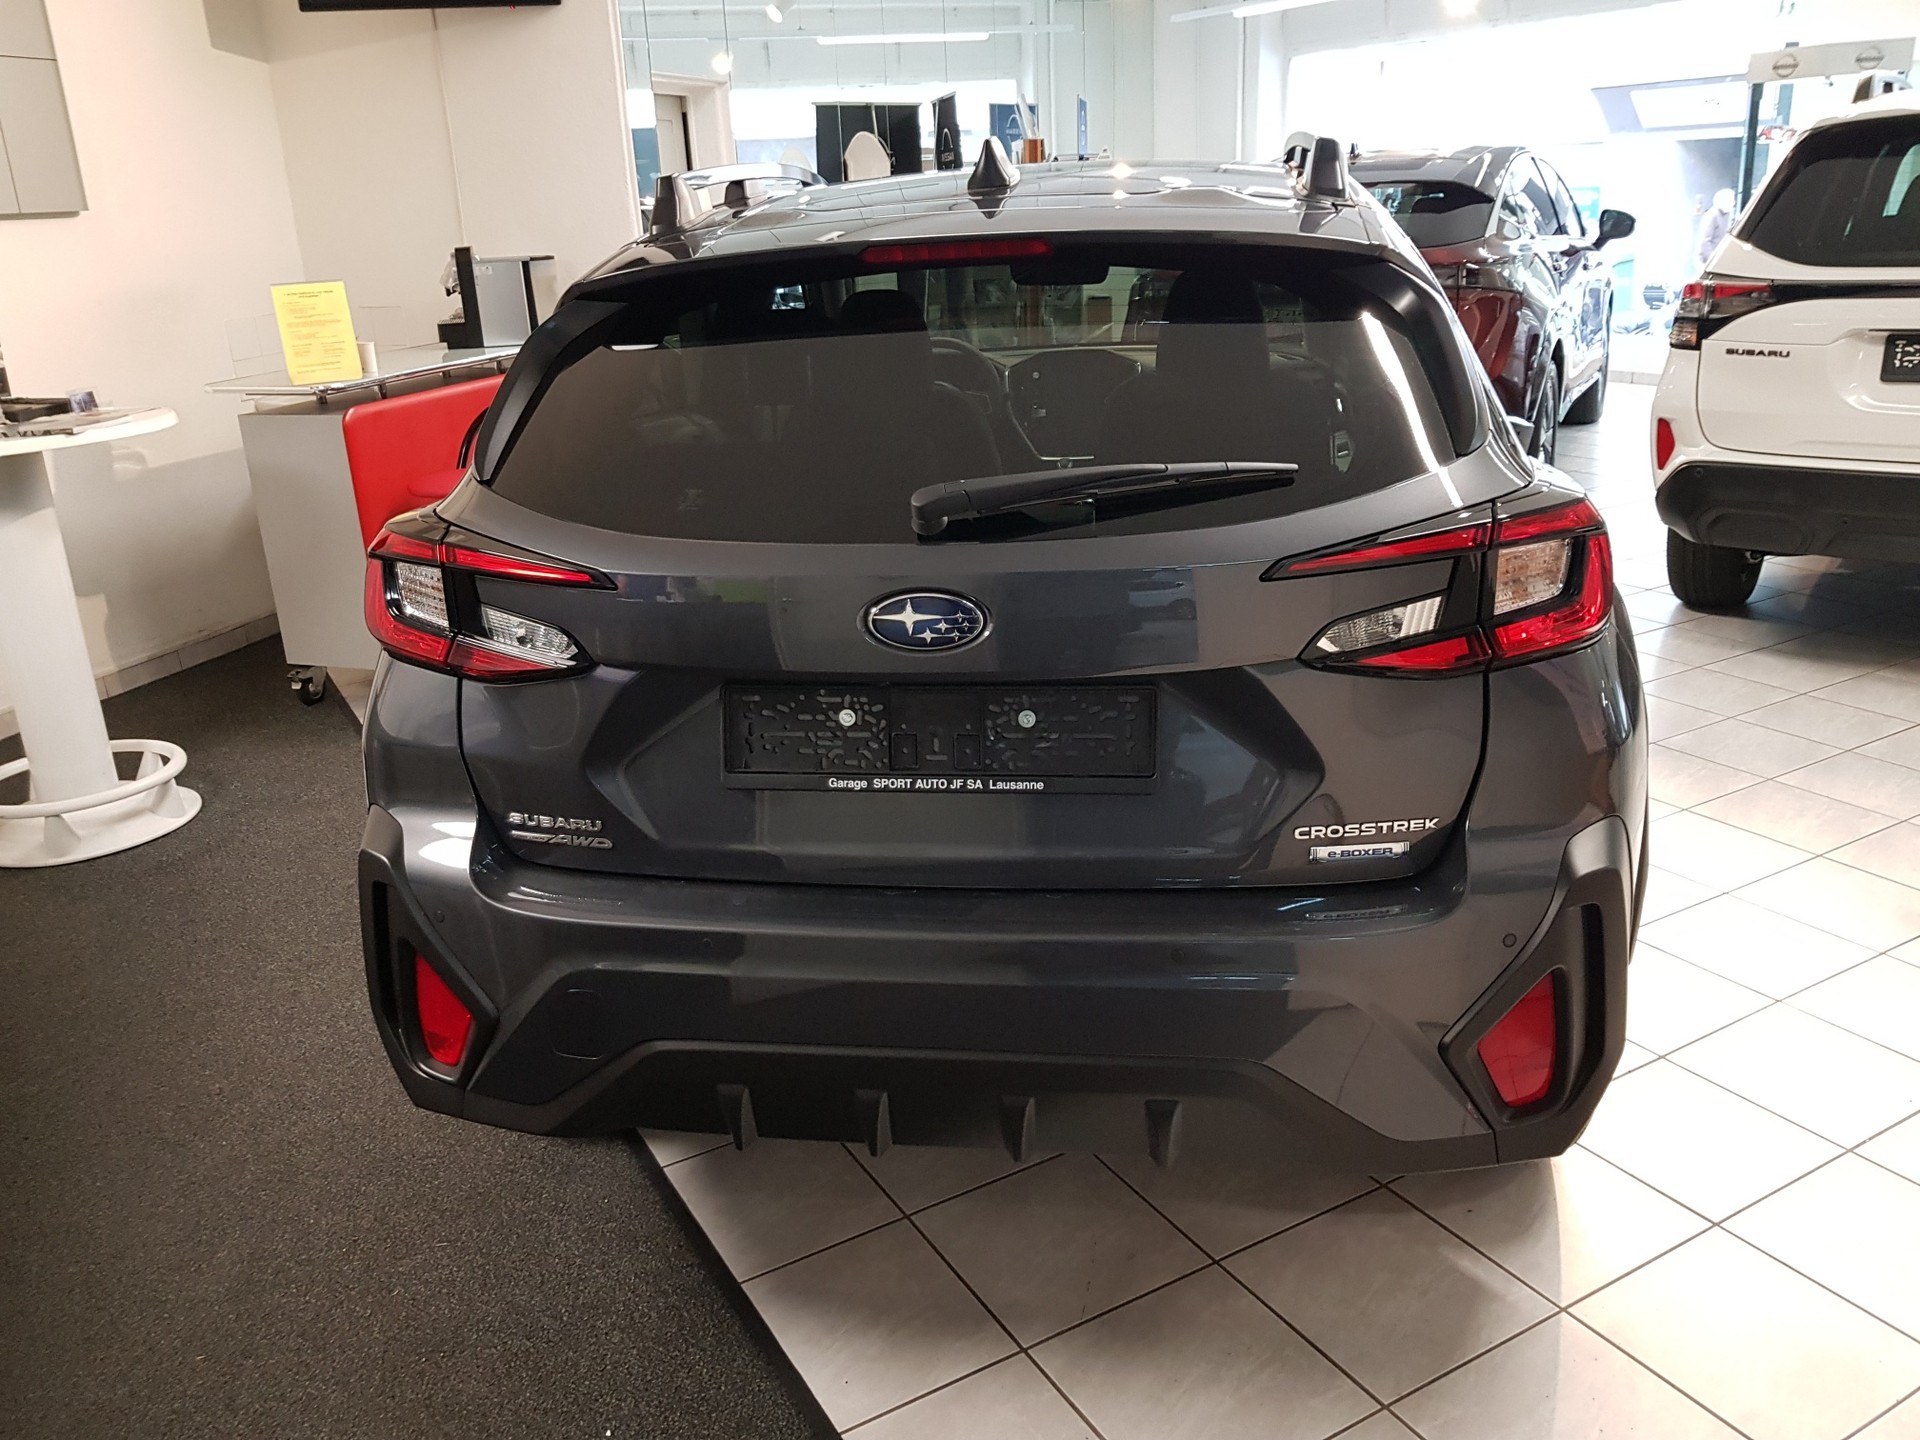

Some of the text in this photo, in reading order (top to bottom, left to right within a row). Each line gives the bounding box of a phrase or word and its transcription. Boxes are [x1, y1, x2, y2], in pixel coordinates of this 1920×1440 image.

[1725, 348, 1790, 358] SUBARU
[828, 777, 1045, 790] Garage SPORT AUTO JF SA Lausanne
[508, 812, 603, 832] SUBARU
[1294, 817, 1440, 840] CROSSTREK
[548, 834, 614, 849] AWD
[1327, 847, 1393, 859] e-BOXER
